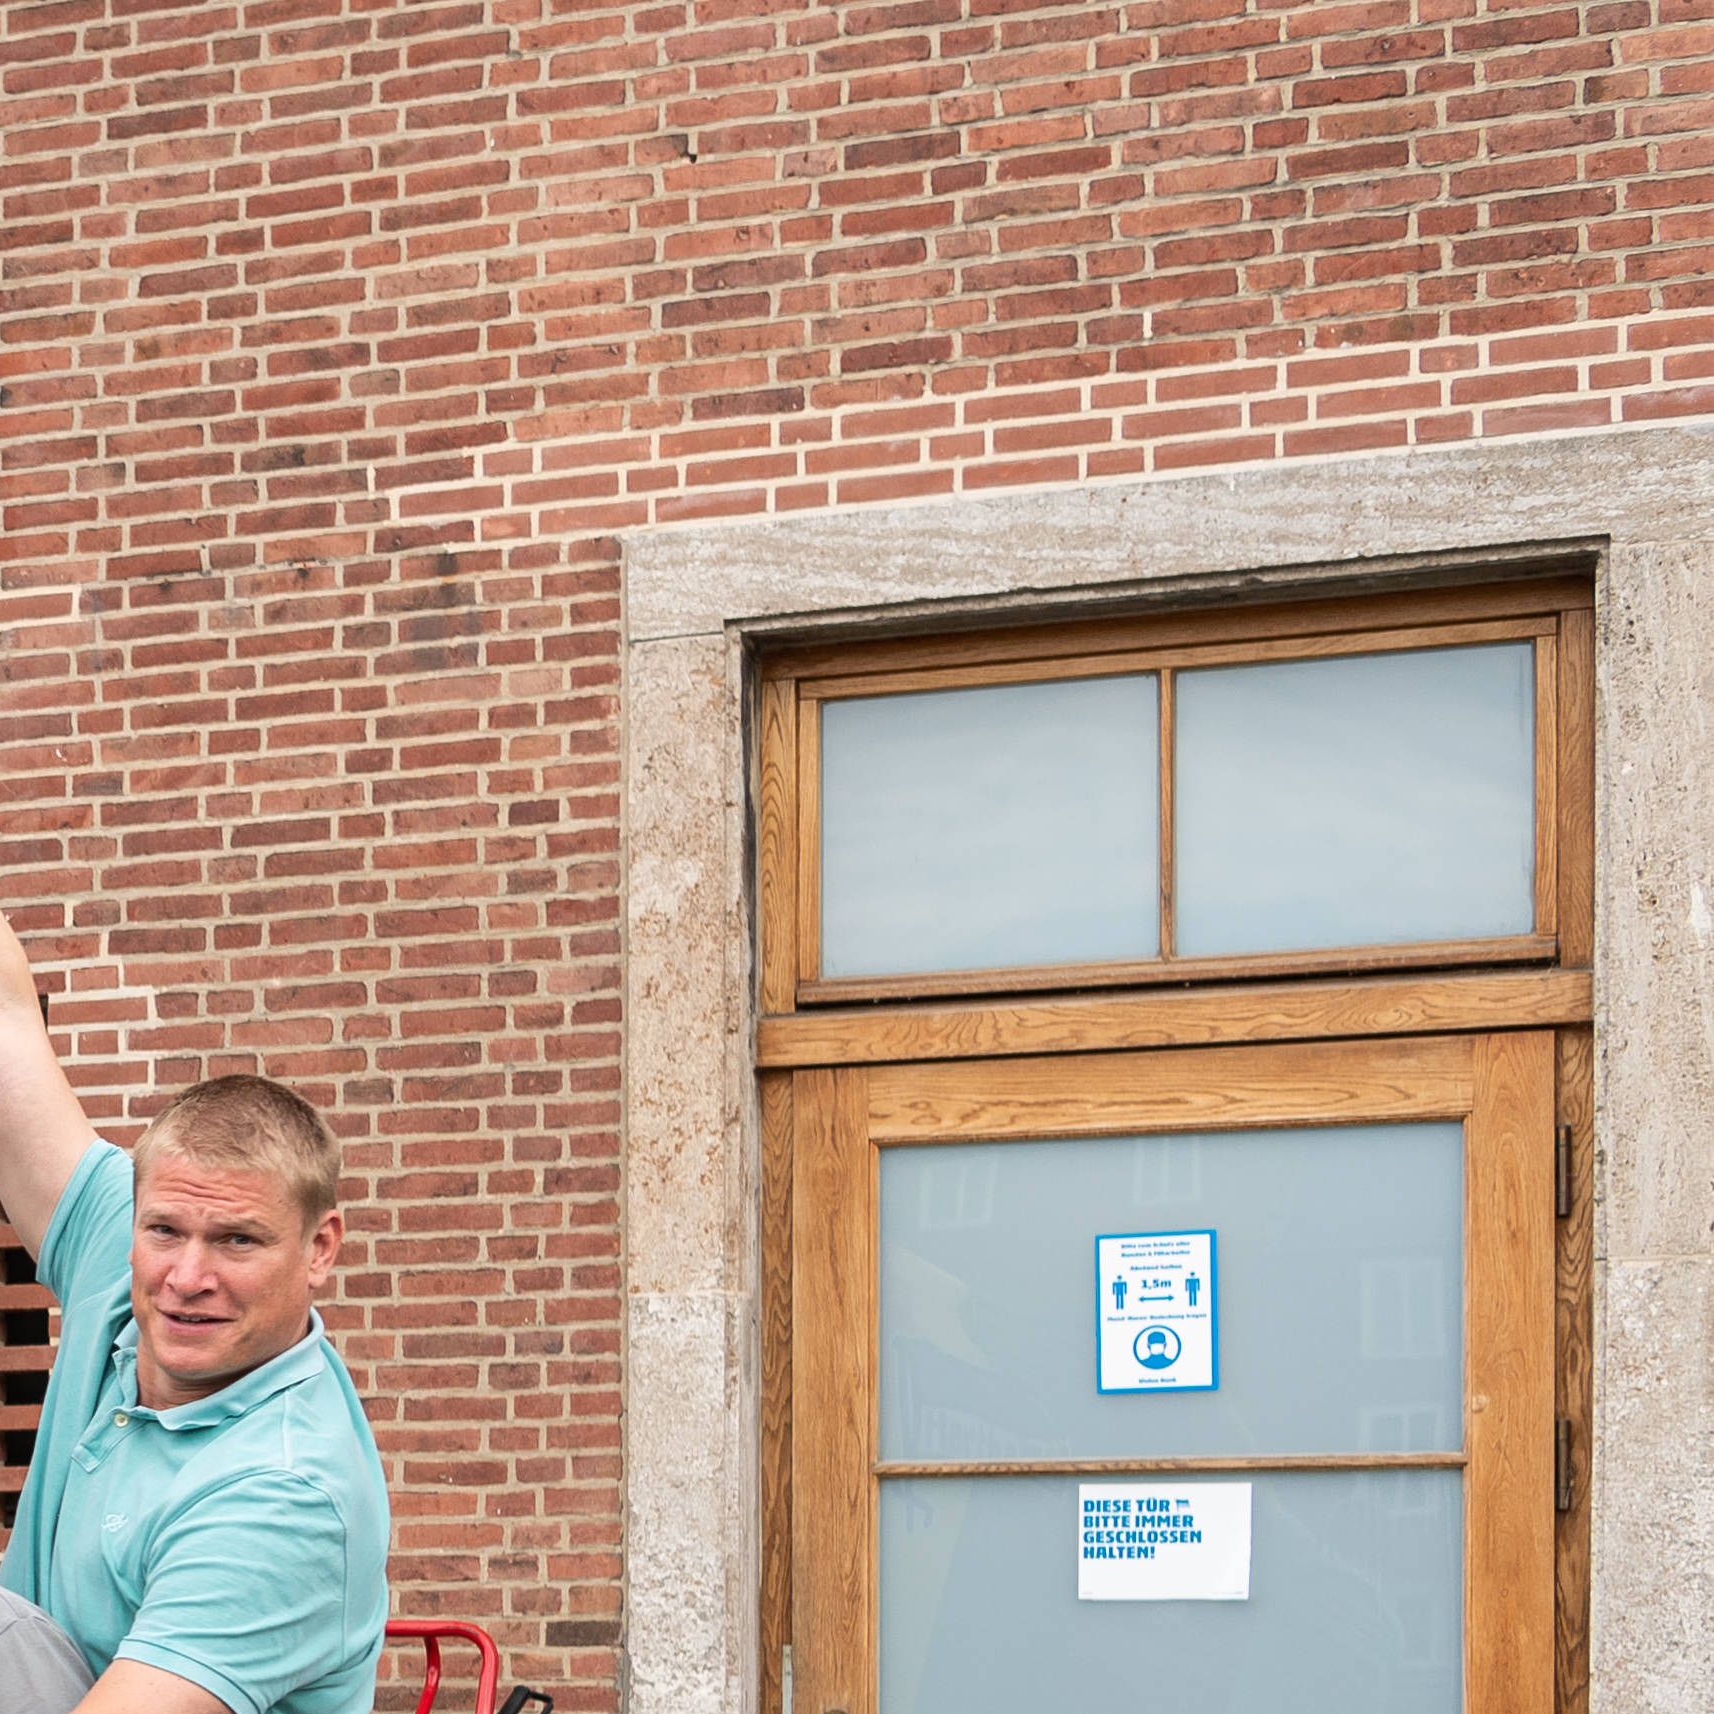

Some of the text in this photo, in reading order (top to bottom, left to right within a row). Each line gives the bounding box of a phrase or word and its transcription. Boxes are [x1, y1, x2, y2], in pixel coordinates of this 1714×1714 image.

[1083, 1497, 1170, 1513] DIESE TÜR
[1083, 1515, 1194, 1528] BITTE IMMER
[1083, 1530, 1202, 1544] GESCHLOSSEN
[1083, 1546, 1156, 1559] HALTEN!
